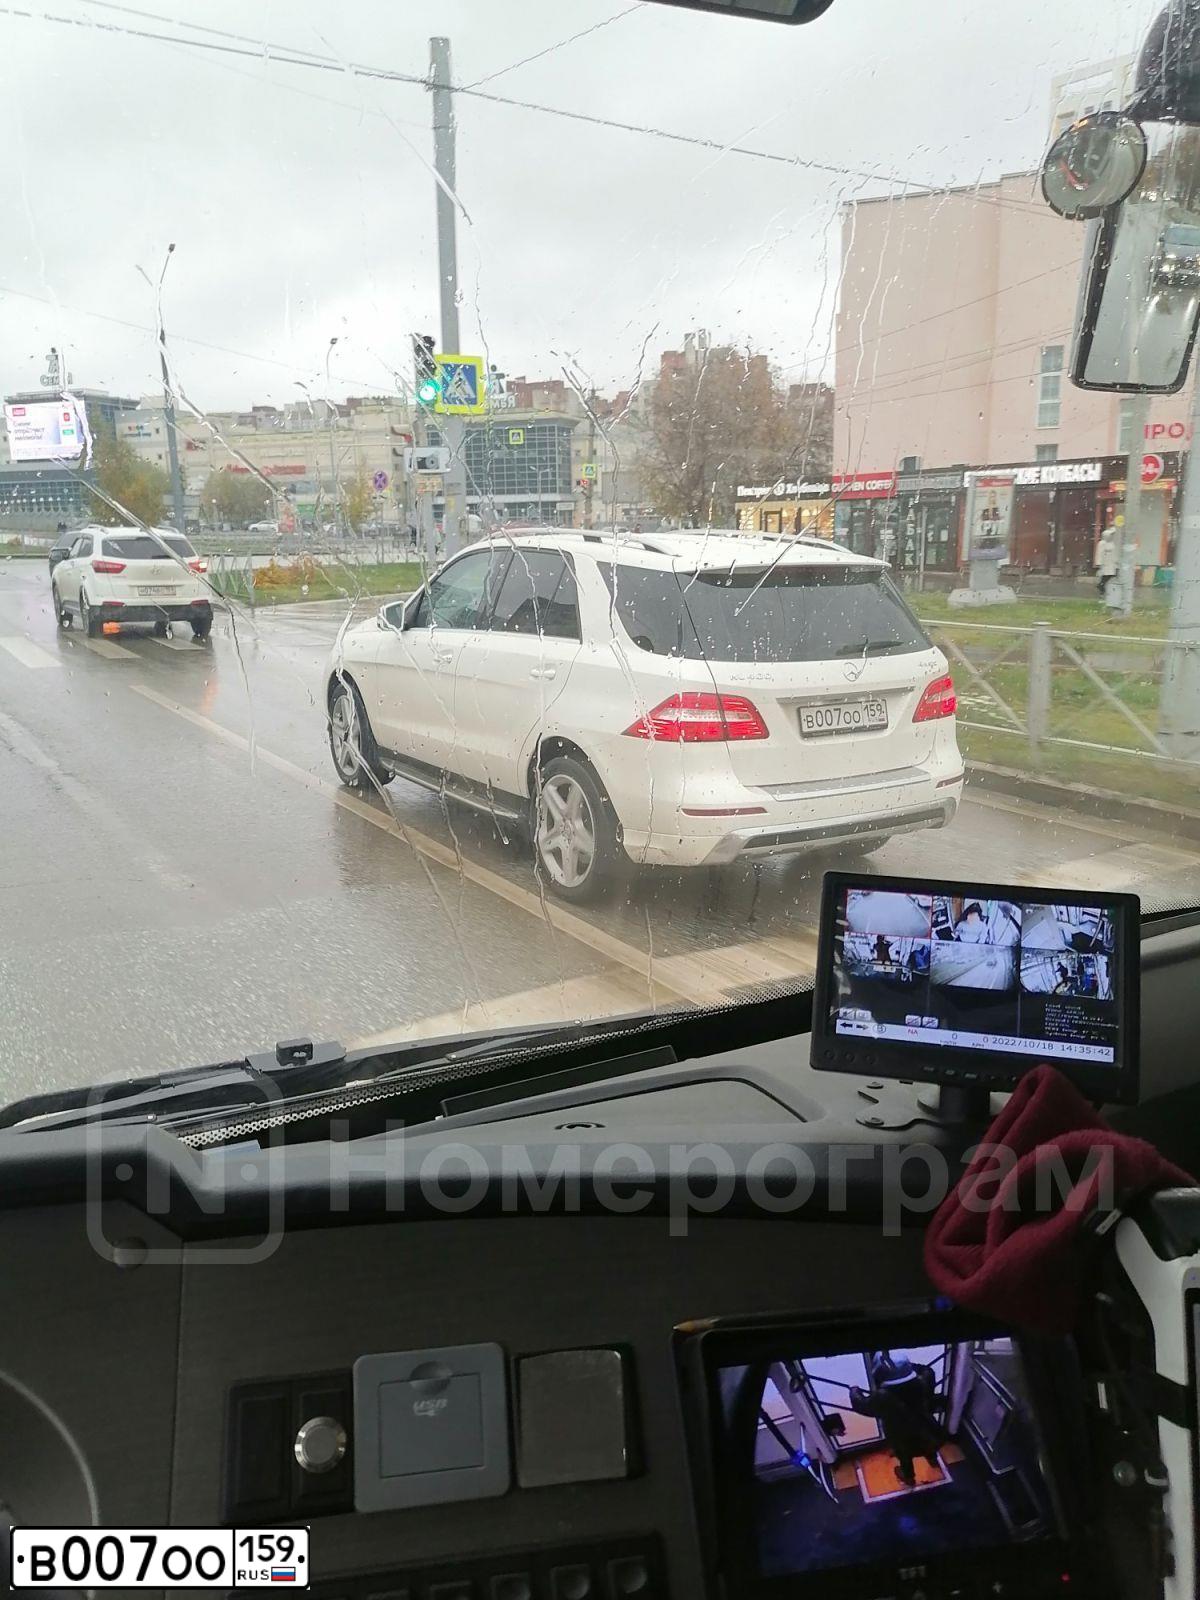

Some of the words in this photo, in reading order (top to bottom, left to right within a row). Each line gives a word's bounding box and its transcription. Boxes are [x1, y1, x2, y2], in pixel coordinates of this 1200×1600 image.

[806, 708, 861, 729] В007ОО
[863, 703, 882, 718] 159
[992, 1036, 1054, 1051] 2022/10/18
[1060, 1044, 1111, 1057] 14:35:42
